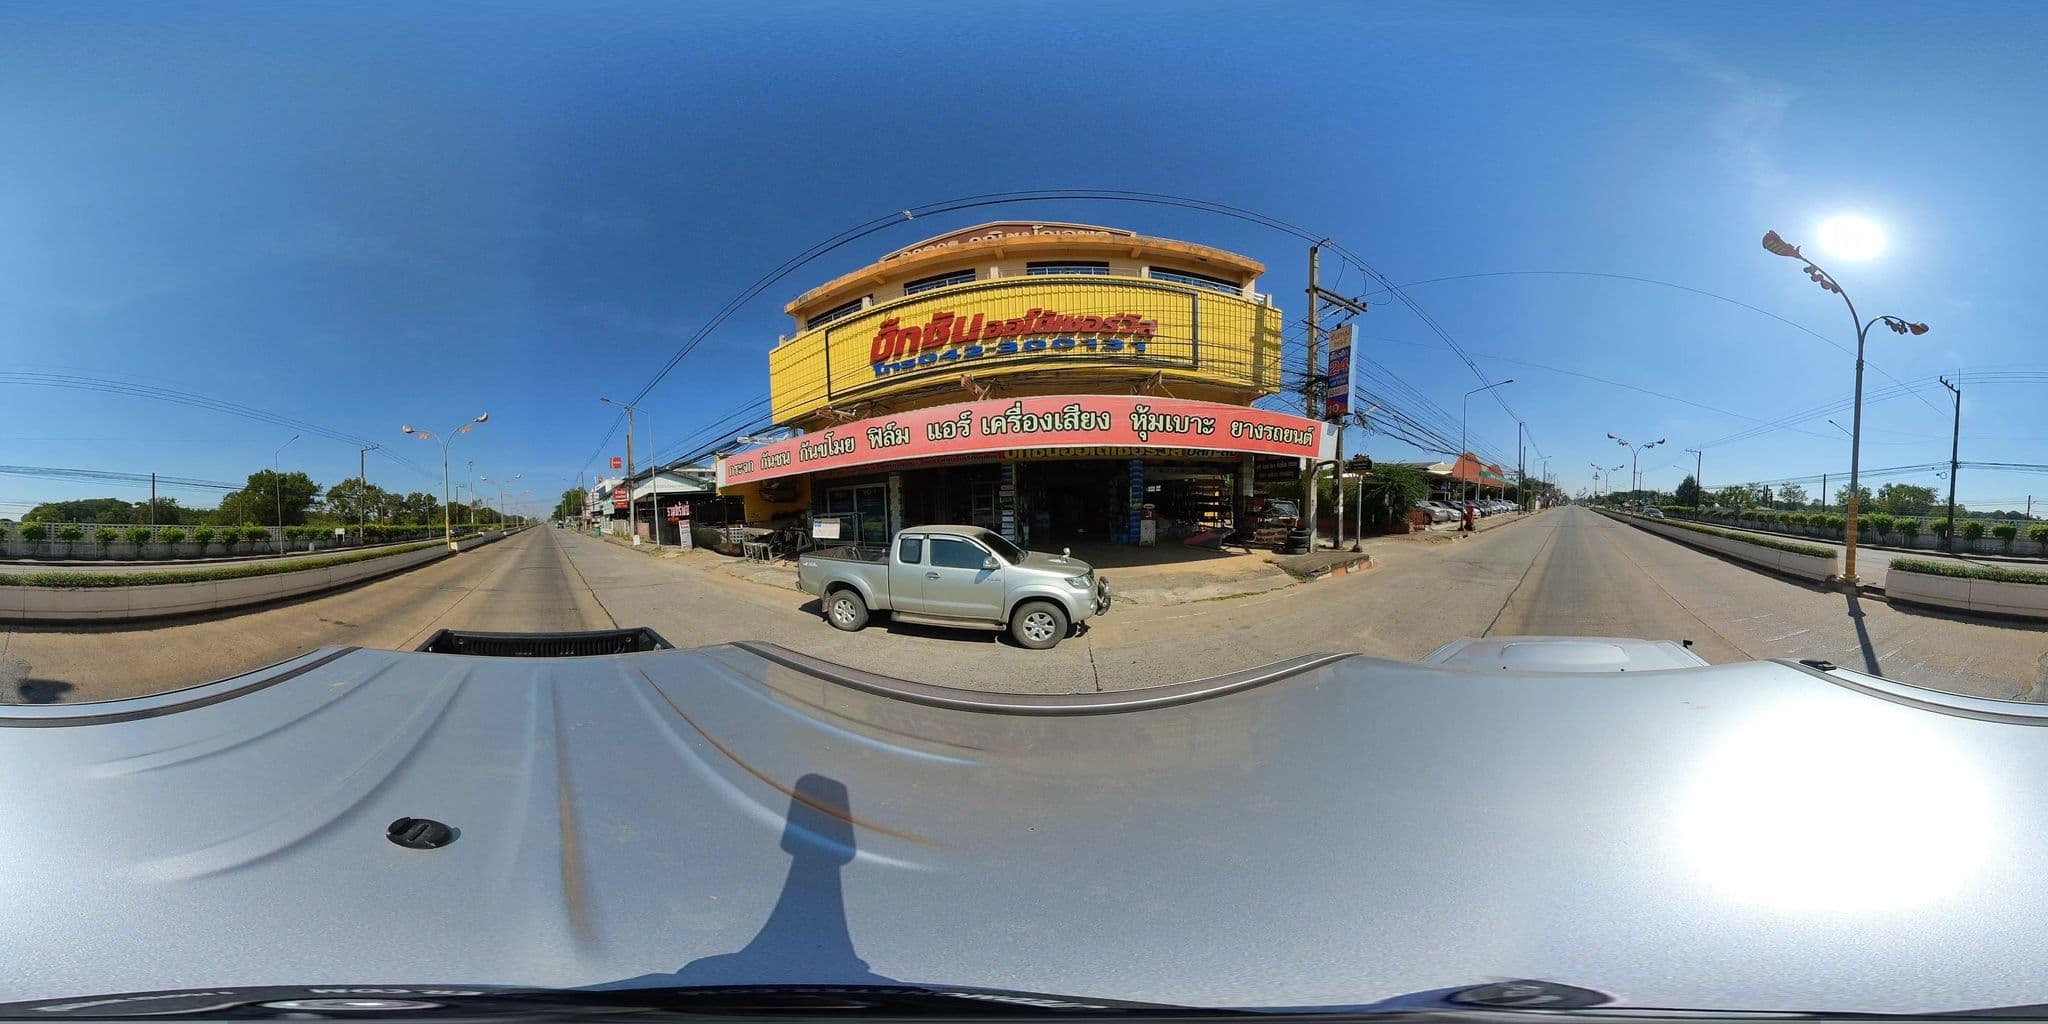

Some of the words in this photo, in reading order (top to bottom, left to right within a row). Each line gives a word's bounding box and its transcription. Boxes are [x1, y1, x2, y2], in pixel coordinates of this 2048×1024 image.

[729, 460, 754, 477] กระจก
[760, 451, 791, 471] กันชน
[799, 431, 855, 463] กันขโมย
[867, 421, 910, 450] ฟิล์ม
[927, 410, 973, 441] แอร์
[981, 400, 1111, 436] เครื่องเสียง
[1130, 404, 1216, 442] หุ้มเบาะ
[1230, 419, 1314, 447] ยางรถยนต์
